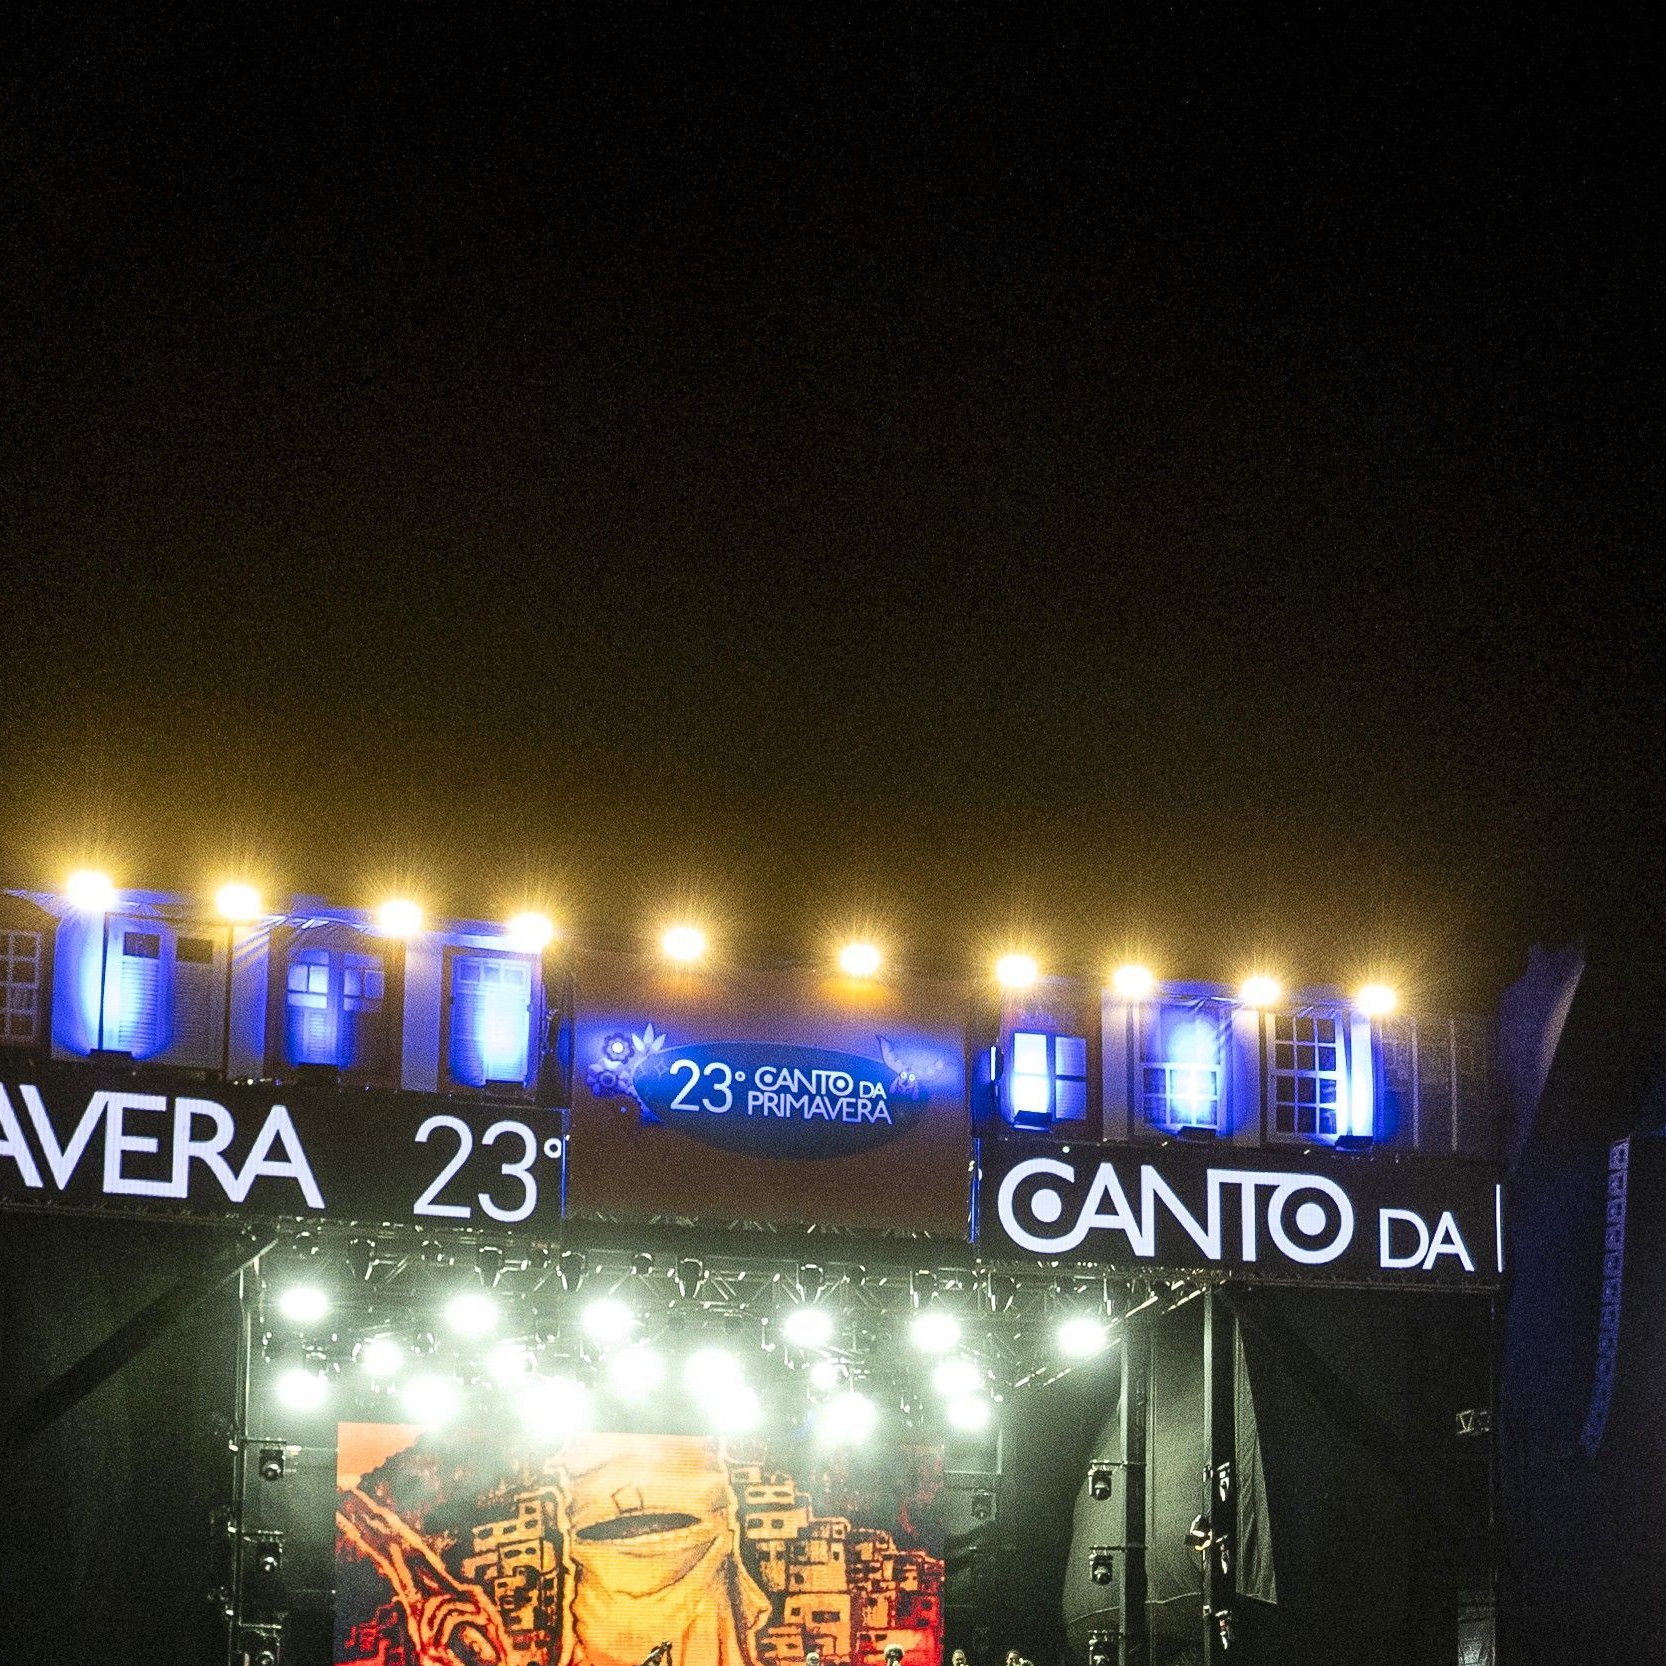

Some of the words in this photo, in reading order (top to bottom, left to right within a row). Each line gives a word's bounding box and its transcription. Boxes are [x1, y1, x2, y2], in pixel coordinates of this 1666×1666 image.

[754, 1066, 854, 1097] CANTO
[858, 1080, 887, 1100] DA
[747, 1090, 893, 1125] PRIMAVERA
[996, 1156, 1355, 1265] CANTO
[1378, 1207, 1476, 1273] DA
